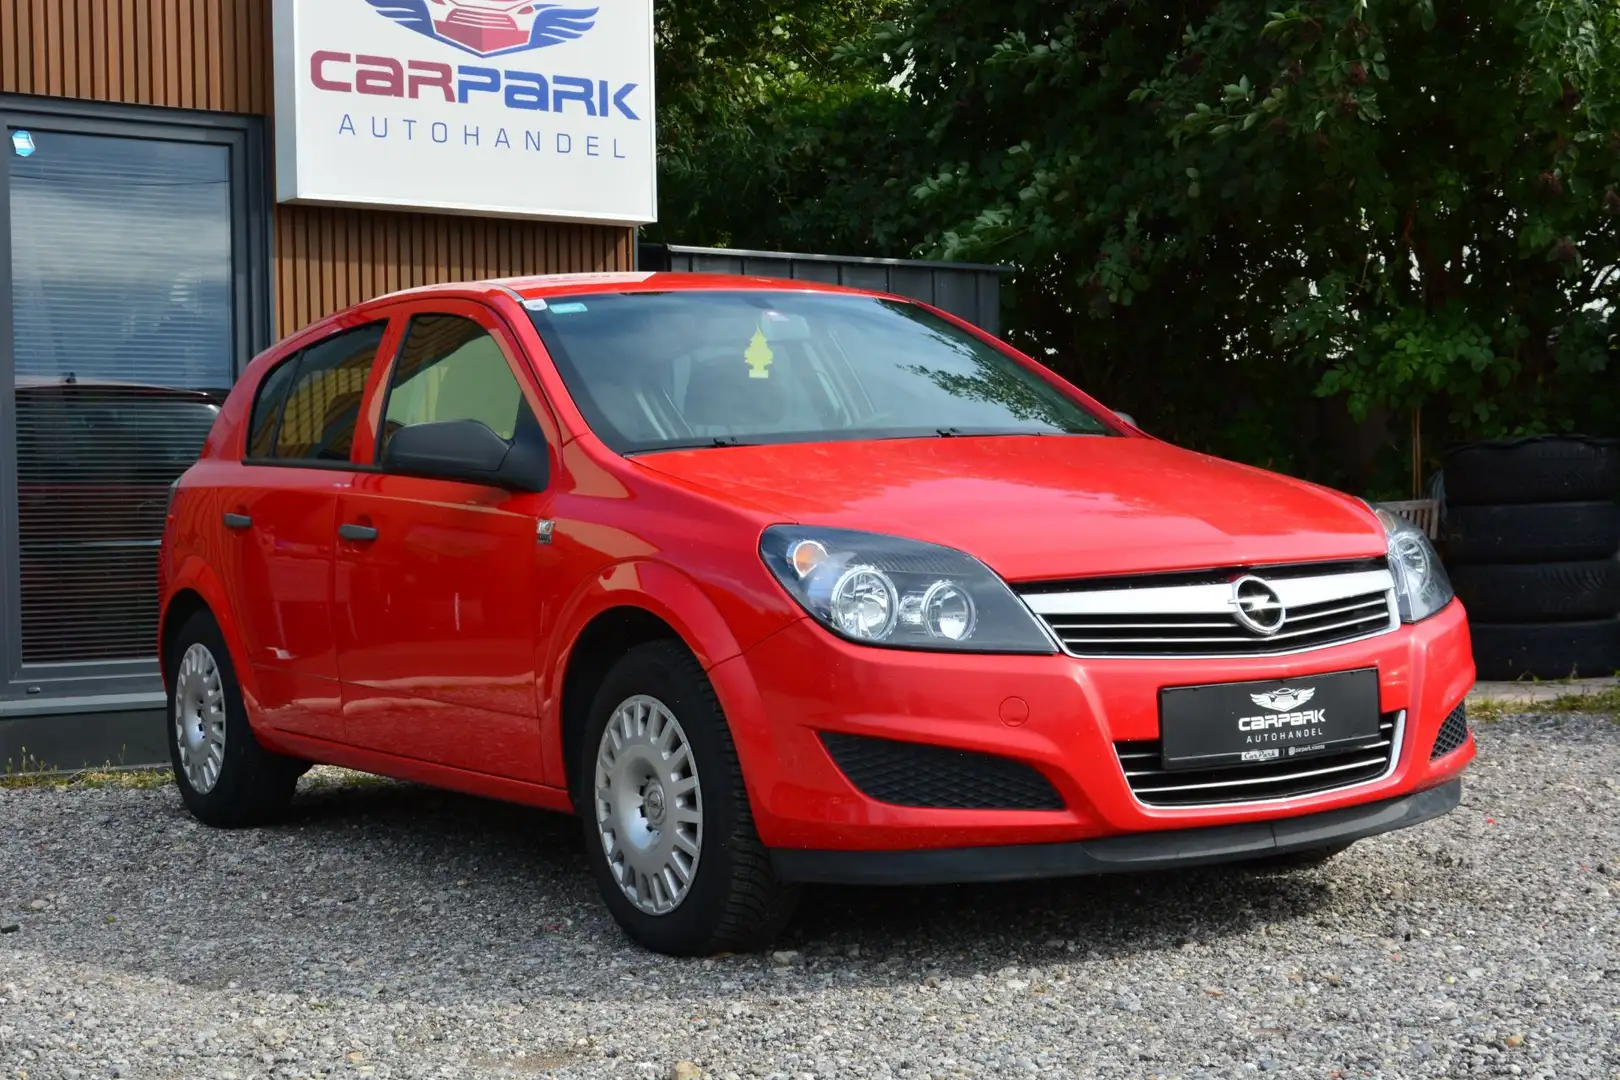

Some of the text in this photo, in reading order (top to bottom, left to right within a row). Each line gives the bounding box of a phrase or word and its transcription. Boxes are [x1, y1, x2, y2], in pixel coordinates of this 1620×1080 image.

[310, 50, 641, 121] CARPARK
[338, 114, 626, 159] AUTOHANDEL
[1238, 708, 1326, 731] CARPARK
[1246, 728, 1323, 744] AUTOHANDEL
